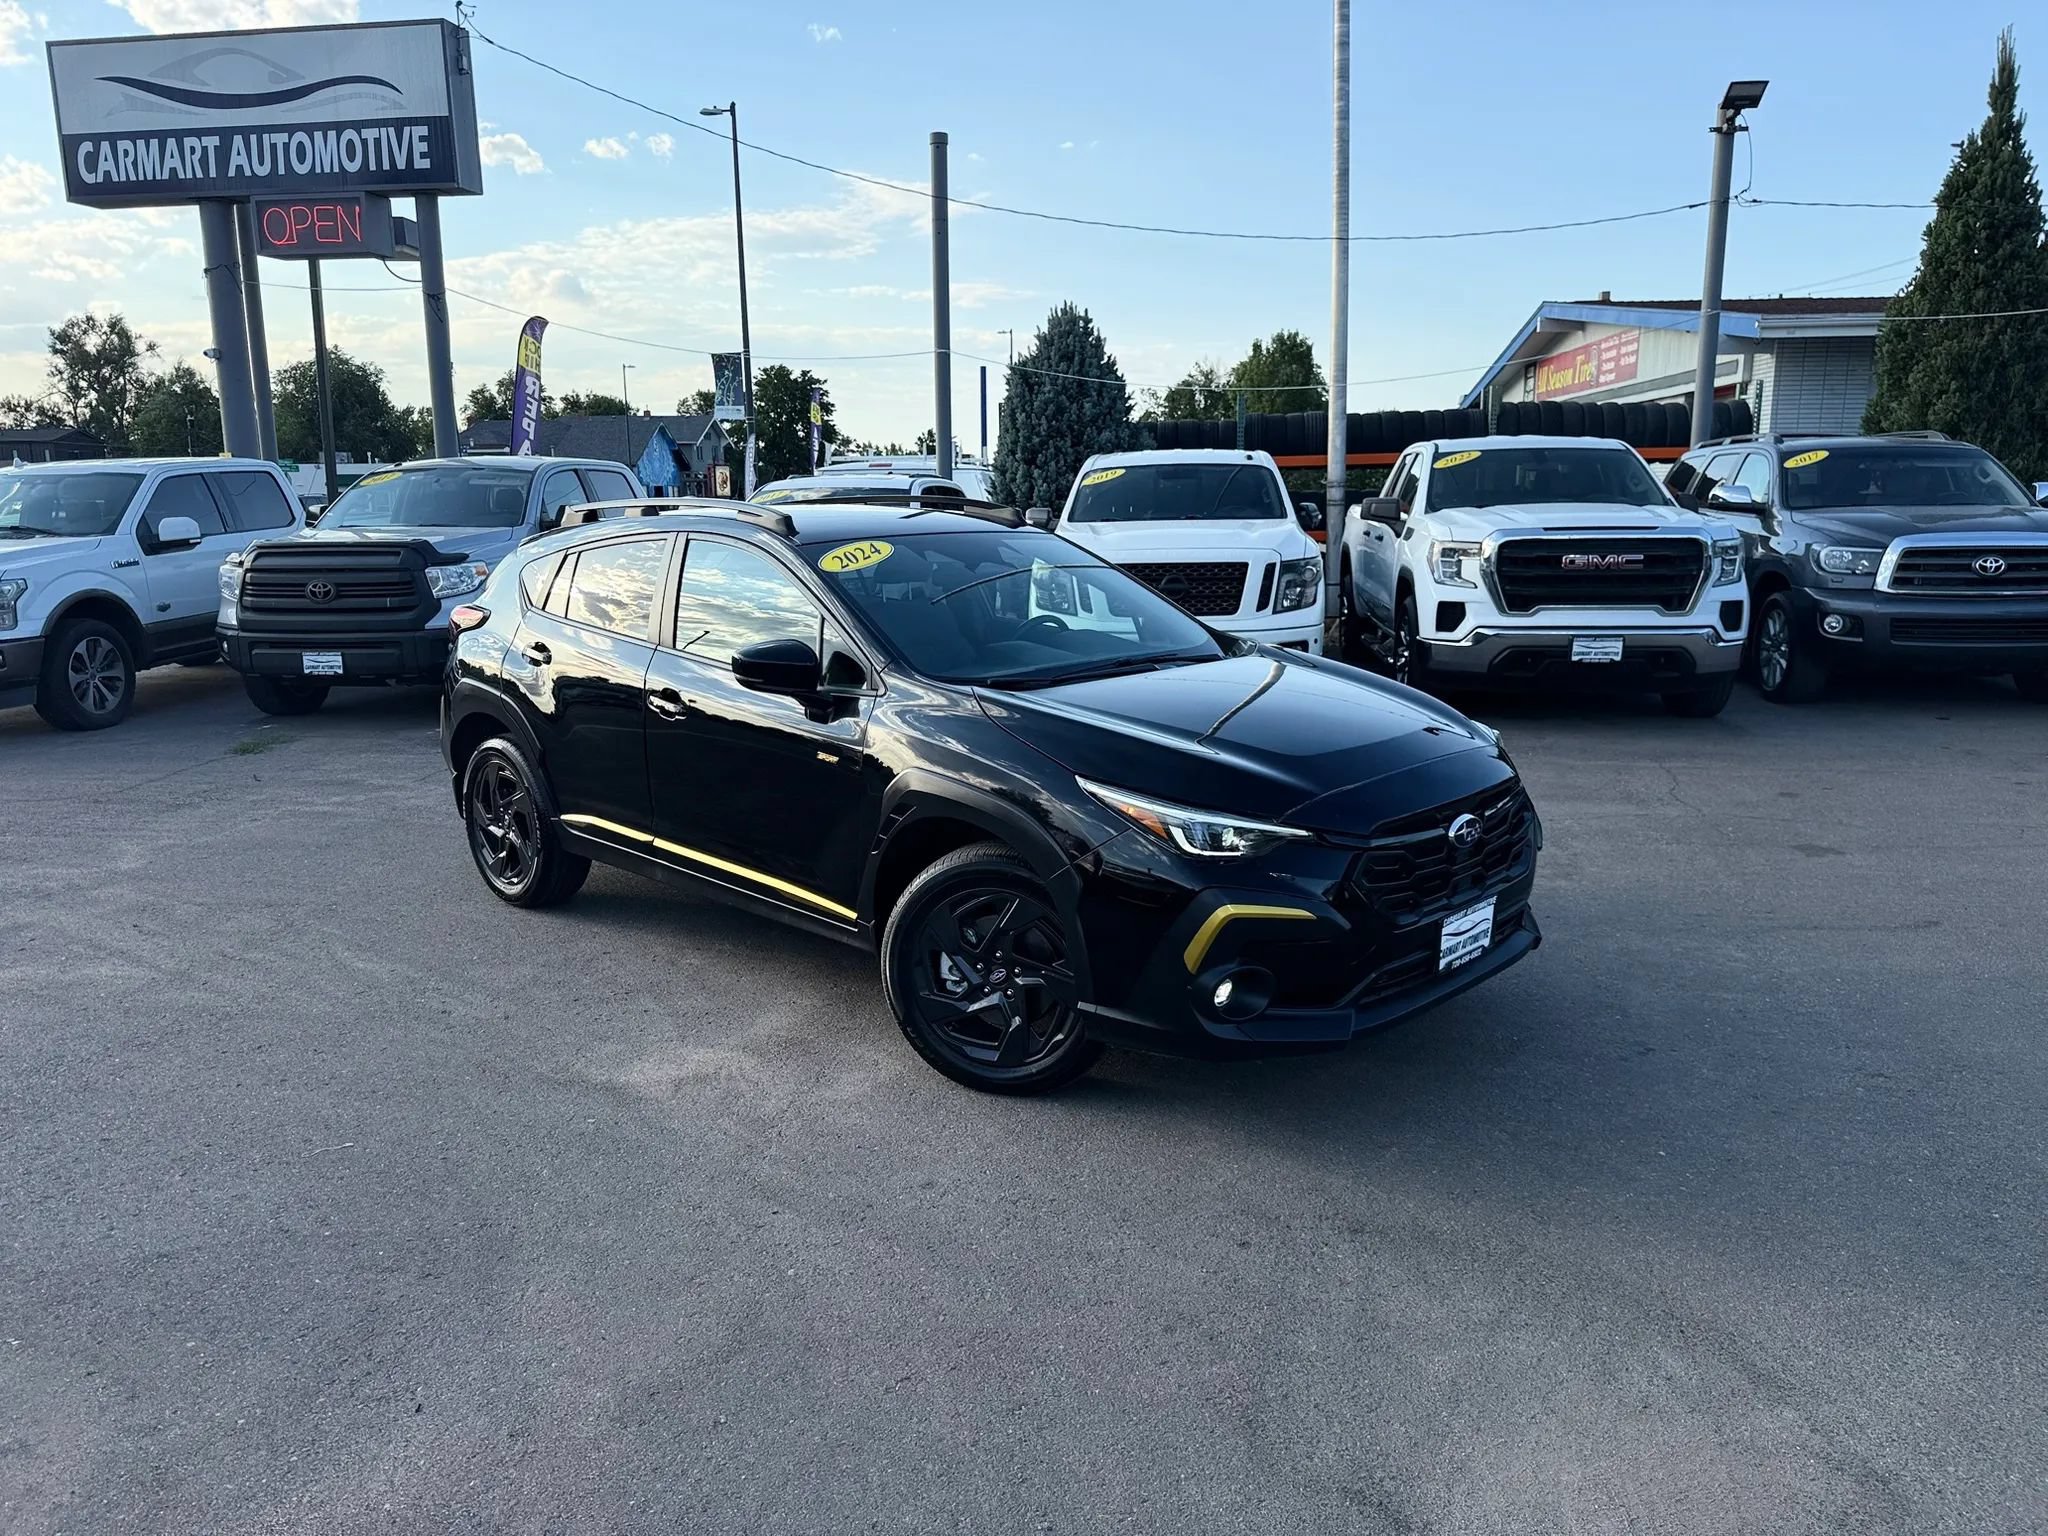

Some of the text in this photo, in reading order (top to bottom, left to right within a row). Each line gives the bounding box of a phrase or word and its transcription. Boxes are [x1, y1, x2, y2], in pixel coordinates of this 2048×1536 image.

[77, 125, 431, 184] CARMART AUTOMOTIVE
[263, 205, 362, 246] OPEN
[1547, 365, 1574, 392] Season
[1443, 452, 1472, 466] 2022
[1793, 452, 1819, 466] 2017
[1090, 470, 1117, 483] 2019
[831, 542, 881, 569] 2024
[1561, 554, 1644, 570] GMC
